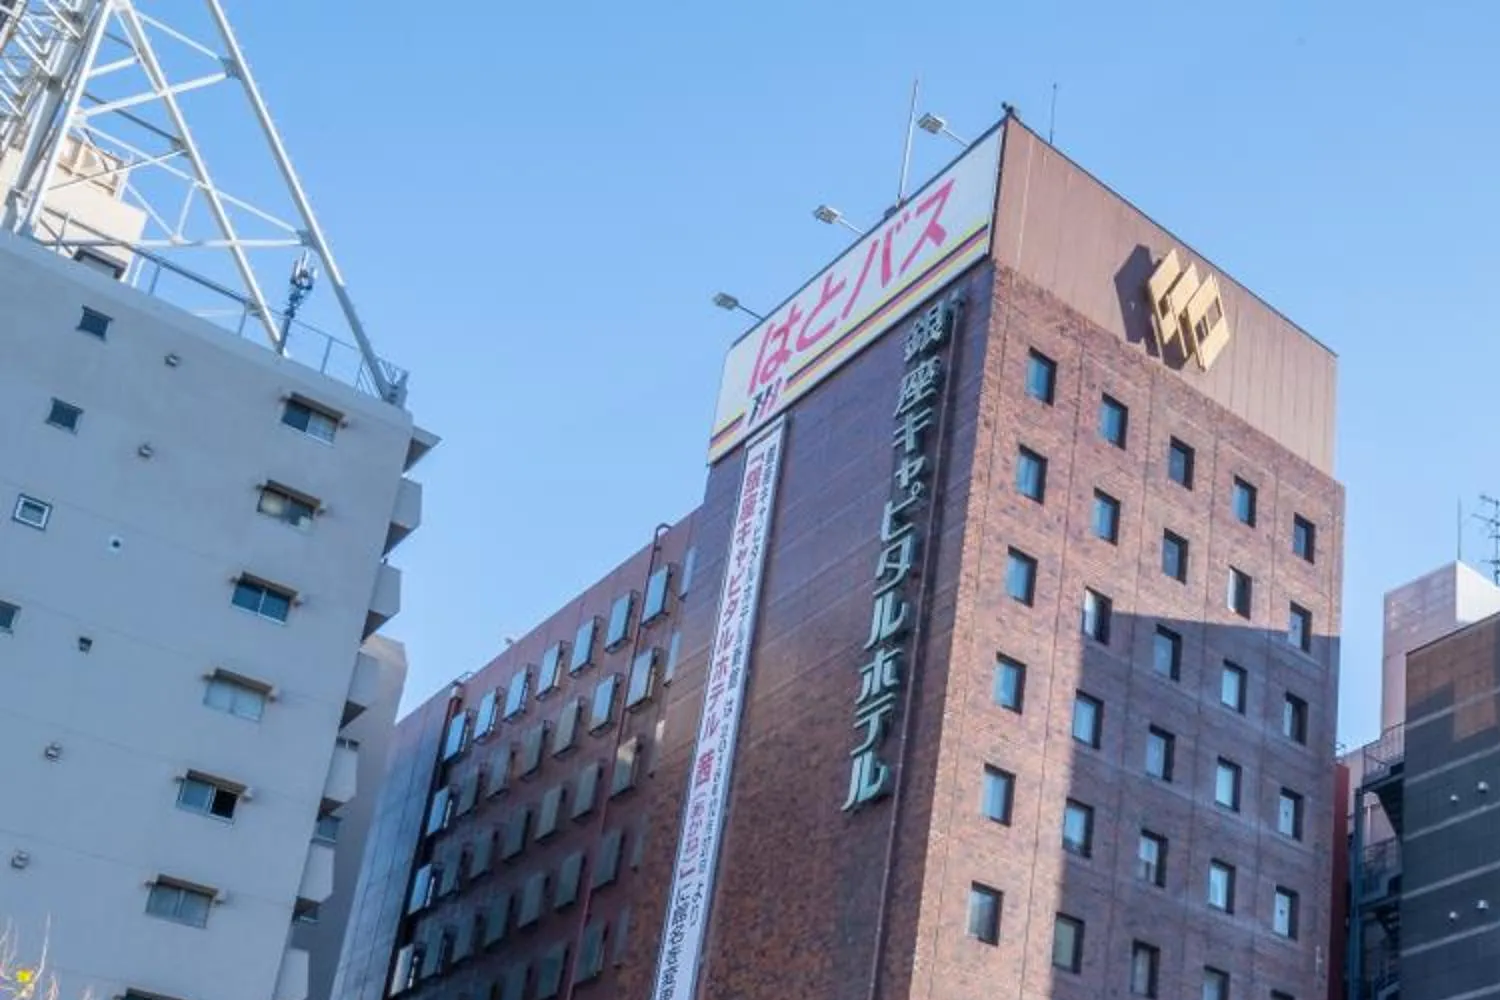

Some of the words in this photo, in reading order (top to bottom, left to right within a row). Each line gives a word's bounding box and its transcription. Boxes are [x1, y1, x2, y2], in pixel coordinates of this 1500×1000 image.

[749, 178, 957, 398] はとバス
[841, 297, 944, 812] 銀座キャピタルホテル
